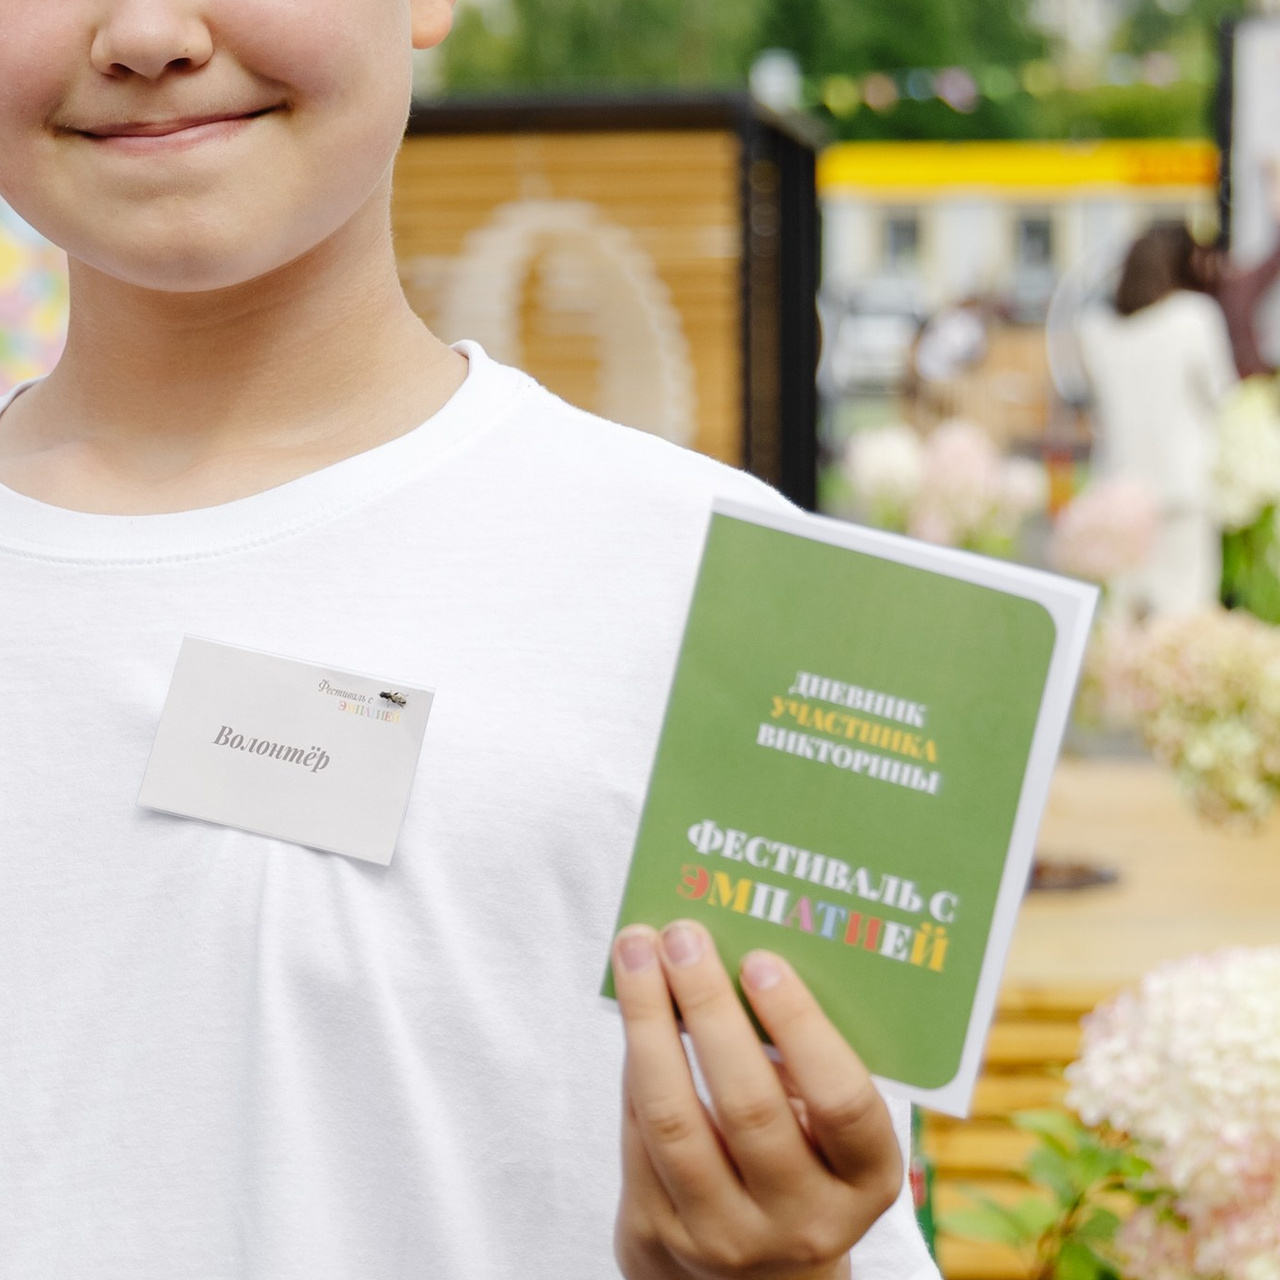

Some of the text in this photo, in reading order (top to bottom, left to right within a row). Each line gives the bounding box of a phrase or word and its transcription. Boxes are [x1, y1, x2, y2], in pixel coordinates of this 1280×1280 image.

[318, 679, 366, 703] Фестиваль
[788, 670, 928, 729] ДНЕВНИК
[212, 725, 331, 774] Волонтёр
[756, 722, 941, 796] ВИКТОРИНЫ
[771, 695, 938, 764] УЧАСТНИКА
[687, 819, 959, 923] ФЕСТИВАЛЬ С
[676, 864, 949, 973] ЭМПАТИЕЙ
